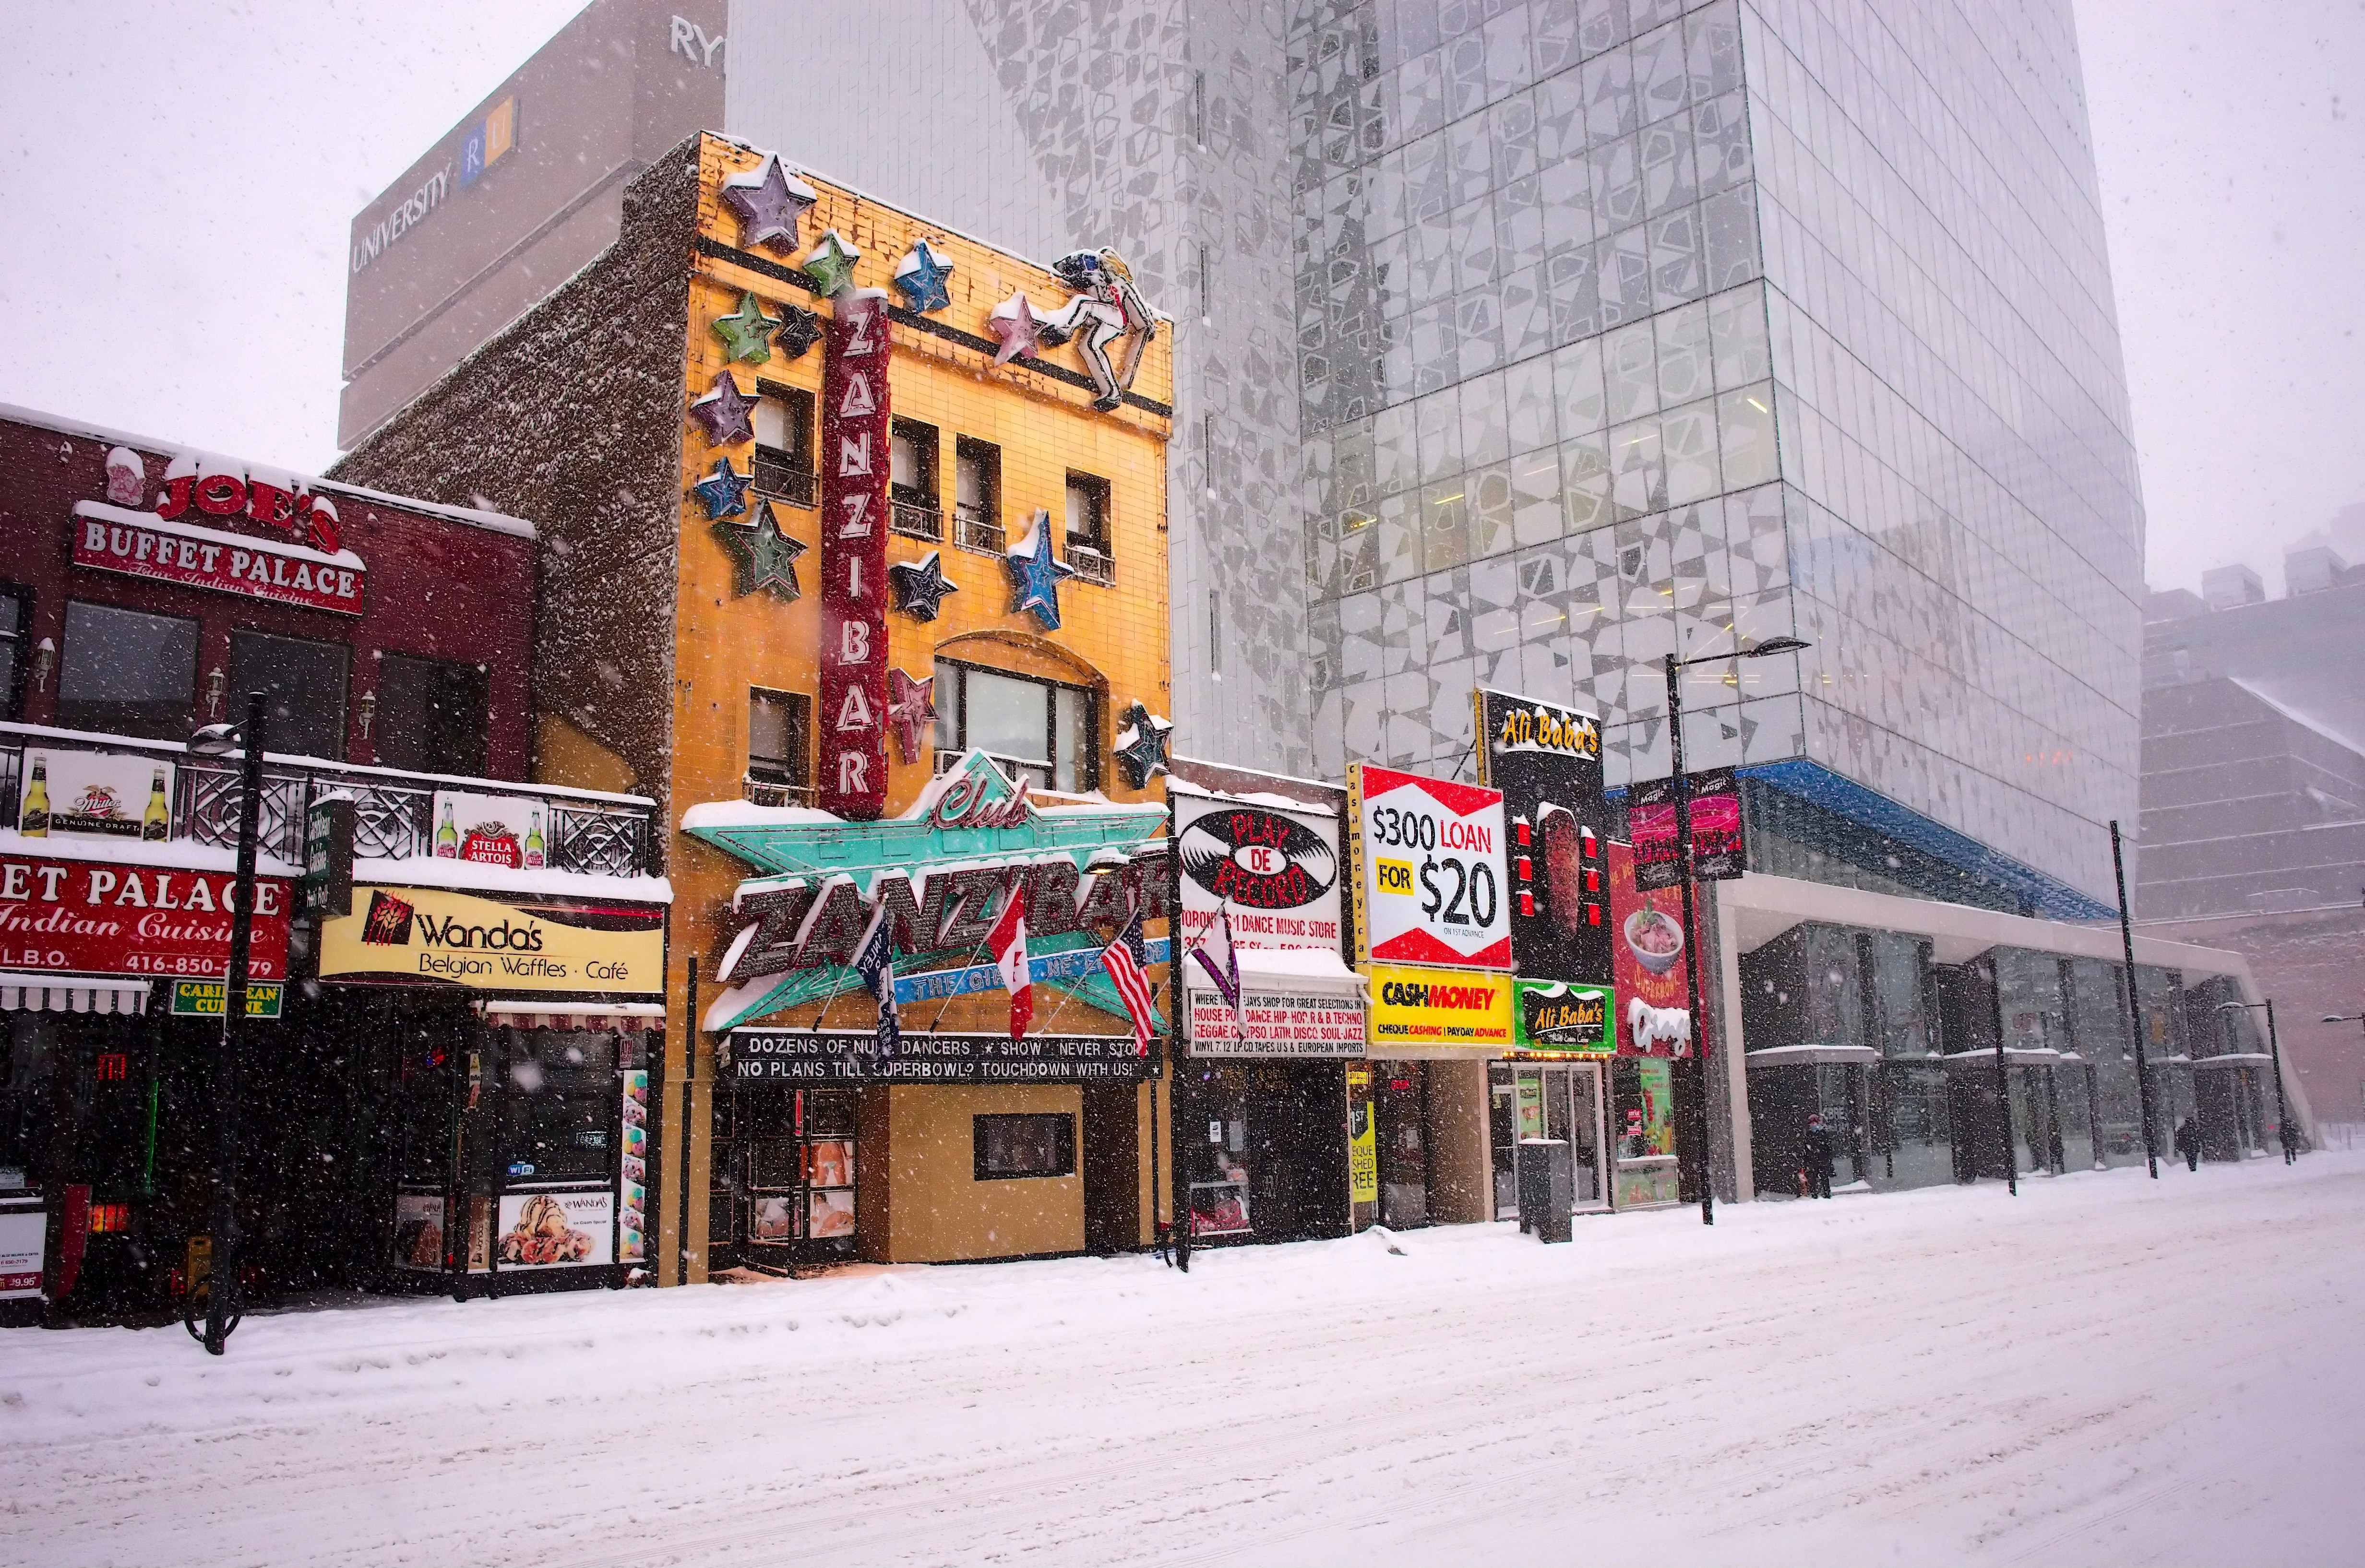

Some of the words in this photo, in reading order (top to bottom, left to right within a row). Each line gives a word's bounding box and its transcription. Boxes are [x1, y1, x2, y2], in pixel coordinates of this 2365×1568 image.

[352, 162, 452, 273] UNIVERSITY
[156, 473, 340, 556] JOE'S
[84, 522, 222, 573] BUFFET
[230, 550, 357, 599] PALACE
[838, 310, 877, 795] ZANZIBAR
[1504, 715, 1530, 744] Ali
[1537, 713, 1598, 753] Baba's
[1701, 778, 1727, 794] Magic
[73, 796, 121, 815] Miller
[934, 777, 1031, 828] Club
[1640, 789, 1665, 805] Magic
[55, 819, 101, 827] GENUINE
[309, 810, 331, 842] Caribbean
[1230, 813, 1290, 849] PLAY
[1373, 805, 1436, 851] $300
[1439, 819, 1492, 855] LOAN
[471, 839, 512, 853] STELLA
[310, 843, 327, 874] Cuisine
[470, 851, 512, 864] ARTOIS
[1251, 848, 1272, 872] DE
[1212, 858, 1306, 907] RECORD
[1378, 863, 1411, 890] FOR
[1420, 854, 1496, 928] $20
[137, 912, 268, 945] Cuisie
[717, 854, 1183, 983] ZANZIBAR
[1242, 915, 1274, 934] DANCE
[1276, 917, 1306, 936] MUSIC
[1309, 920, 1337, 939] STORE
[415, 914, 543, 952] Wanda's
[1444, 928, 1451, 936] ON
[1462, 929, 1484, 938] ADVANCE
[126, 955, 273, 976] 416-850-79
[419, 953, 492, 978] Belgian
[500, 956, 567, 978] Waffles
[585, 961, 629, 980] Café
[179, 984, 277, 1001] CARIEAN
[912, 974, 957, 1000] THE
[195, 998, 263, 1014] CUINE
[1194, 994, 1218, 1006] WHERE
[1263, 997, 1280, 1008] SHOP
[1282, 998, 1295, 1008] FOR
[1297, 998, 1316, 1009] GREAT
[1318, 999, 1353, 1010] SELECTIONS
[1355, 1000, 1361, 1010] IN
[1310, 1011, 1316, 1024] R
[1317, 1011, 1324, 1025] &
[1535, 1006, 1556, 1030] Ali
[1559, 1002, 1603, 1026] Baba's
[1321, 1027, 1363, 1041] SOUL-JAZZ
[1378, 1024, 1409, 1035] CHEQUE
[1409, 1025, 1442, 1036] CASHING
[1447, 1027, 1474, 1036] PAYDAY
[1474, 1028, 1506, 1038] ADVANCE
[750, 1037, 819, 1054] DOZENS
[826, 1039, 847, 1054] OF
[901, 1040, 970, 1055] DANCERS
[1001, 1042, 1041, 1056] SHOW
[1060, 1042, 1100, 1056] NEVER
[1194, 1041, 1214, 1052] VINYL
[1290, 1042, 1295, 1052] &
[1298, 1042, 1334, 1053] EUROPEAN
[1336, 1043, 1363, 1053] IMPORTS
[737, 1062, 763, 1077] NO
[771, 1062, 825, 1077] PLANS
[832, 1061, 865, 1077] TILL
[981, 1062, 1070, 1077] TOUCHDOWN
[1075, 1062, 1109, 1077] WITH
[1113, 1062, 1133, 1077] US!
[1352, 1145, 1373, 1157] EQUE
[1352, 1158, 1374, 1170] SHED
[1352, 1171, 1374, 1189] REE
[573, 1196, 608, 1208] WANDA'S
